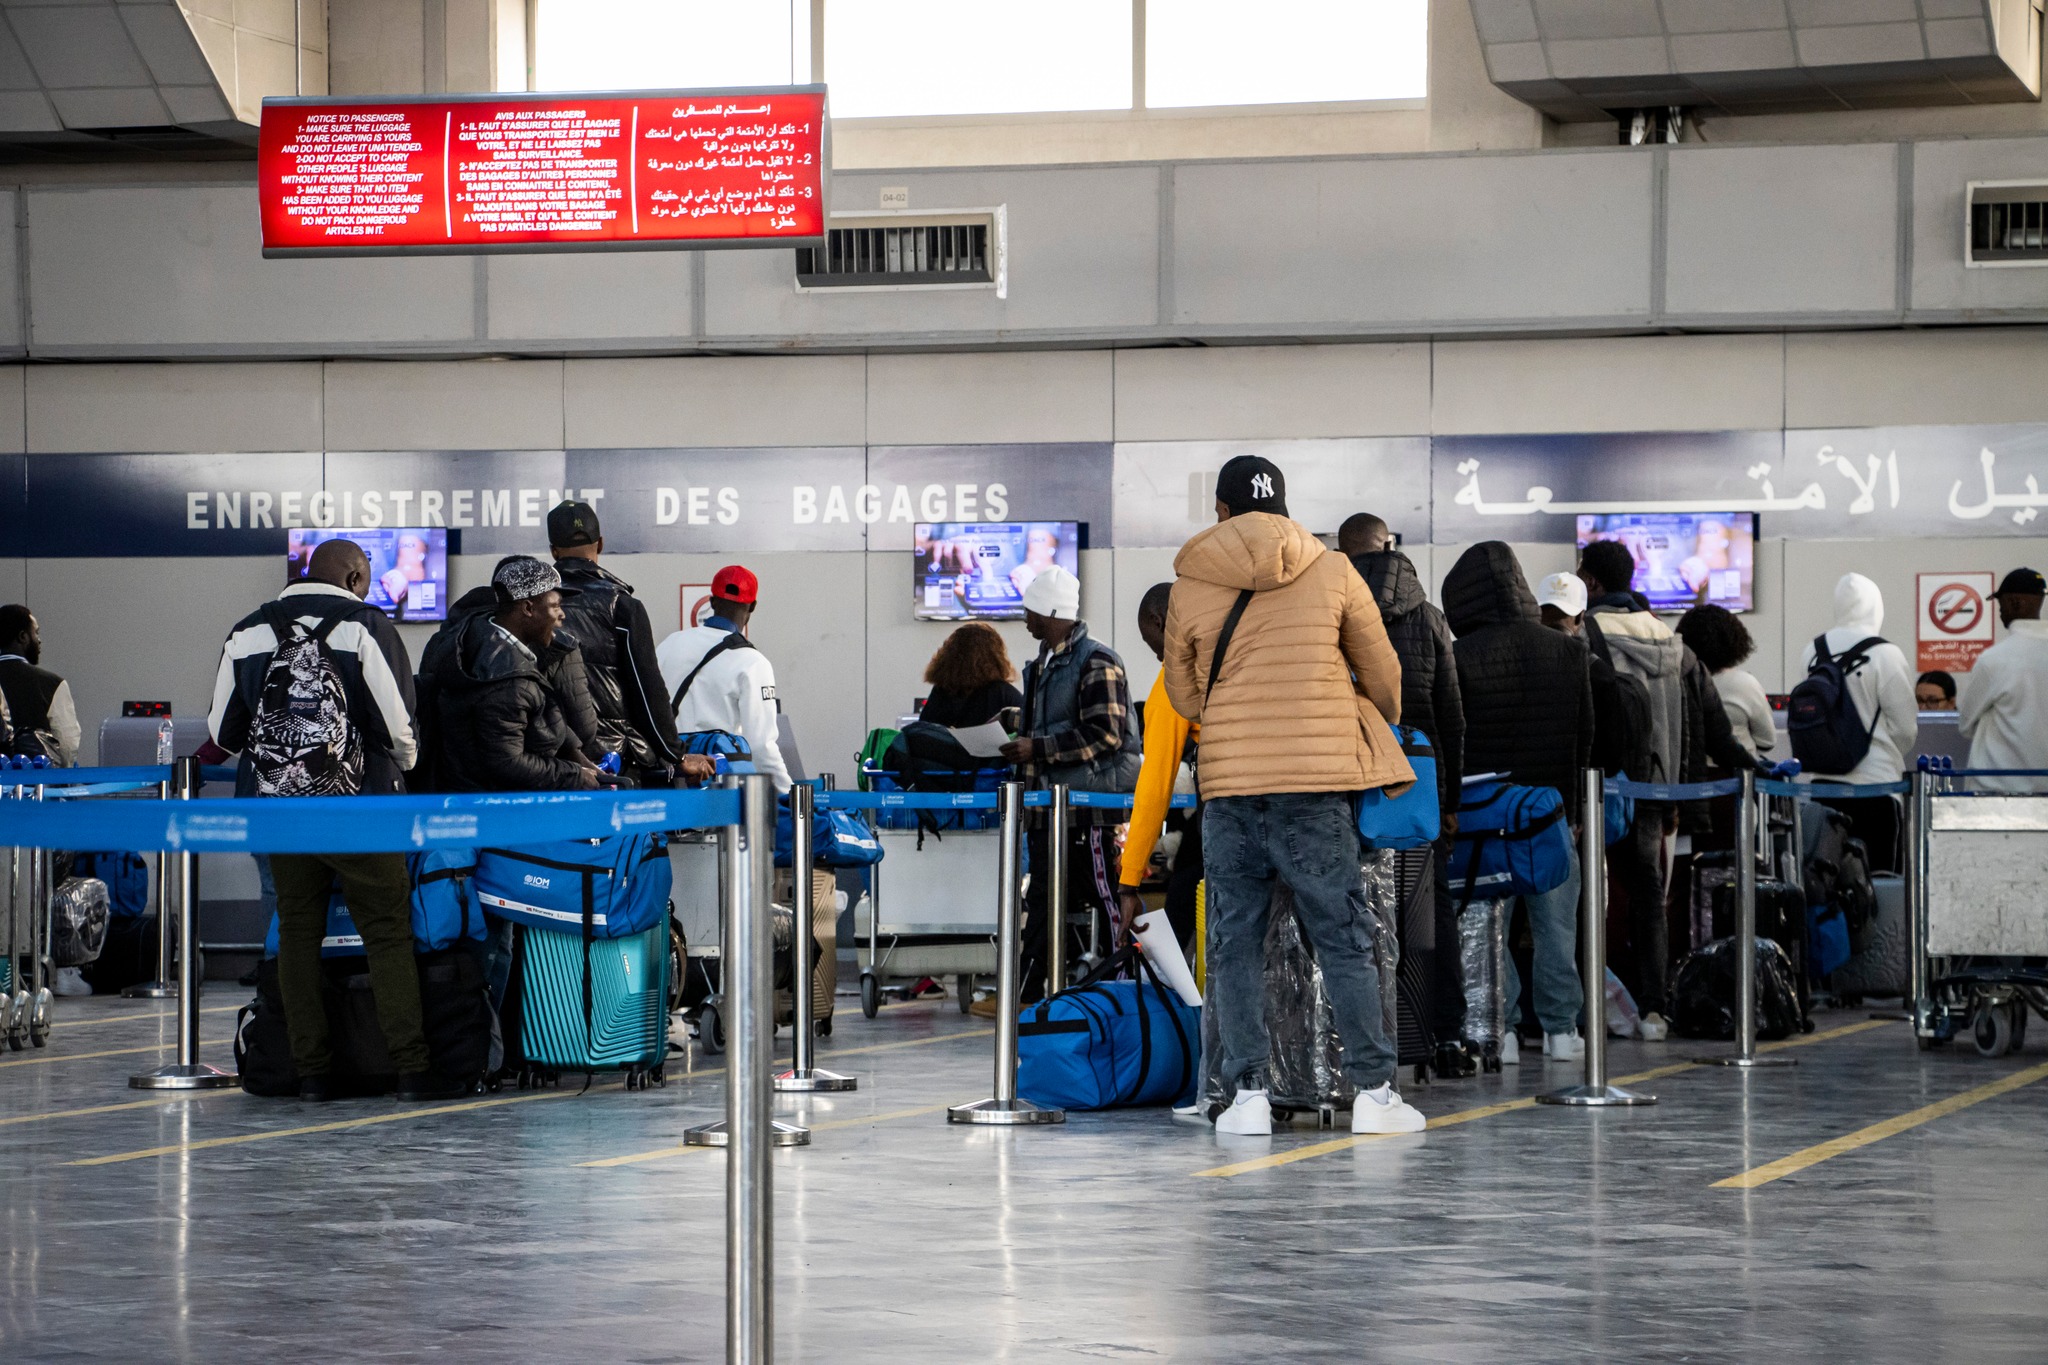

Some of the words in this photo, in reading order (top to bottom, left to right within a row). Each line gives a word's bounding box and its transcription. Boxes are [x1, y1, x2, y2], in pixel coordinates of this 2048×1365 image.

[351, 114, 404, 122] PASSENGERS
[535, 111, 586, 119] PASSAGERS
[330, 124, 353, 132] SURE
[355, 124, 370, 132] THE
[371, 123, 411, 132] LUGGAGE
[479, 122, 500, 130] FAUT
[551, 121, 570, 129] QUE
[571, 120, 582, 128] LE
[584, 119, 620, 128] BAGAGE
[296, 135, 311, 143] YOU
[333, 134, 372, 142] CARRYING
[384, 133, 411, 142] YOURS
[459, 132, 477, 141] QUE
[479, 132, 502, 140] VOUS
[569, 130, 586, 138] EST
[609, 129, 620, 137] LE
[282, 145, 298, 153] AND
[300, 145, 312, 153] DO
[332, 144, 357, 152] LEAVE
[359, 144, 366, 152] IT
[509, 141, 520, 150] ET
[522, 141, 533, 150] NE
[535, 141, 546, 149] LE
[548, 140, 582, 149] LAISSEZ
[584, 140, 601, 148] PAS
[317, 155, 333, 163] NOT
[335, 154, 367, 162] ACCEPT
[369, 154, 379, 162] TO
[381, 154, 409, 162] CARRY
[493, 151, 516, 159] SANS
[297, 165, 324, 173] OTHER
[326, 164, 357, 173] PEOPLE
[368, 164, 407, 172] LUGGAGE
[523, 161, 540, 169] PAS
[542, 161, 553, 169] DE
[555, 160, 617, 169] TRANSPORTER
[282, 175, 317, 183] WITHOUT
[319, 175, 357, 183] KNOWING
[360, 174, 382, 183] THEIR
[384, 174, 423, 183] CONTENT
[479, 172, 520, 180] BAGAGES
[566, 170, 617, 179] PERSONNES
[306, 186, 328, 194] MAKE
[330, 185, 352, 193] SURE
[354, 185, 373, 193] THAT
[375, 185, 387, 193] NO
[389, 185, 408, 193] ITEM
[467, 182, 490, 190] SANS
[492, 182, 503, 190] EN
[555, 181, 566, 189] LE
[283, 196, 299, 204] HAS
[301, 196, 322, 204] BEEN
[324, 195, 352, 204] ADDED
[353, 195, 364, 203] TO
[366, 195, 382, 203] YOU
[384, 194, 423, 203] LUGGAGE
[466, 193, 473, 201] IL
[475, 193, 497, 201] FAUT
[548, 191, 566, 200] QUE
[568, 191, 587, 199] RIEN
[606, 188, 621, 198] ÉTÉ
[288, 206, 324, 214] WITHOUT
[326, 206, 348, 214] YOUR
[350, 205, 401, 214] KNOWLEDGE
[402, 205, 419, 213] AND
[514, 202, 537, 211] DANS
[540, 202, 568, 210] VOTRE
[570, 201, 605, 210] BAGAGE
[302, 217, 314, 225] DO
[333, 216, 354, 224] PACK
[356, 216, 407, 224] DANGEROUS
[472, 214, 500, 222] VOTRE
[525, 213, 536, 221] ET
[562, 212, 573, 220] NE
[575, 211, 617, 220] CONTIENT
[326, 227, 364, 235] ARTICLES
[366, 226, 374, 234] IN
[480, 223, 497, 232] PAS
[1250, 472, 1275, 499] NY
[656, 486, 740, 525] DES
[792, 483, 1009, 524] BAGAGES
[532, 876, 551, 887] IOM
